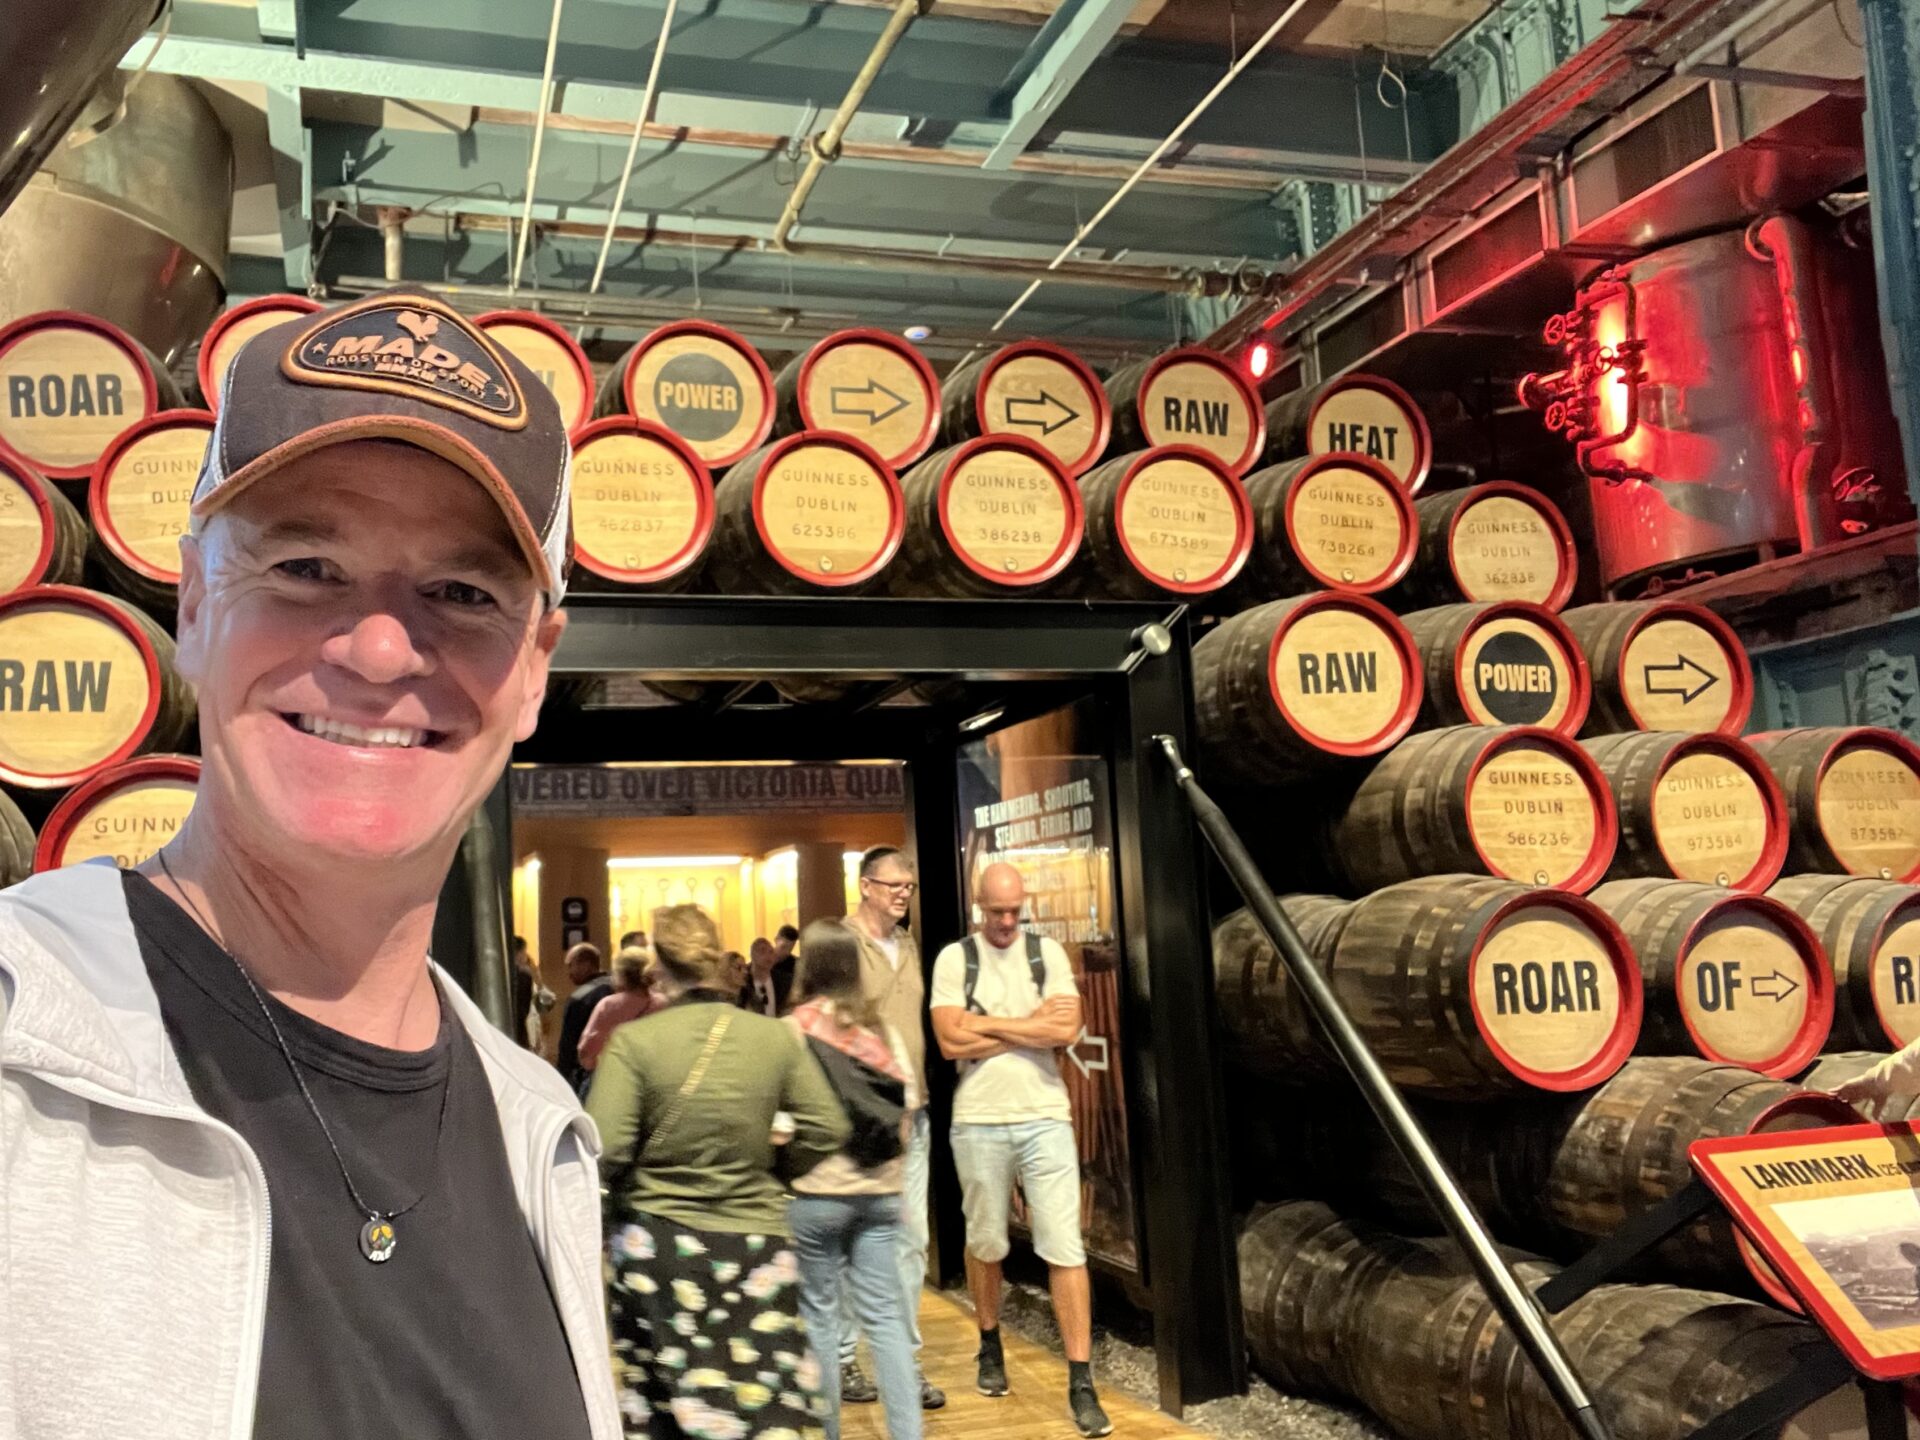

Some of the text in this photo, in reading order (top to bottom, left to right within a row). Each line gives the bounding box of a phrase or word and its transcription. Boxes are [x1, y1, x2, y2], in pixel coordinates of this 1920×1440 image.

[328, 336, 491, 389] MADE
[326, 354, 486, 398] ROOSTER OF SPORT
[8, 374, 123, 418] ROAR
[660, 381, 737, 411] POWER
[1164, 396, 1229, 437] RAW
[1329, 422, 1398, 460] HEAT
[581, 461, 675, 476] GUINNESS
[782, 469, 870, 486] GUINNESS
[966, 475, 1048, 490] GUINNESS
[595, 488, 661, 503] DUBLIN
[1141, 480, 1220, 500] GUINNESS
[1309, 489, 1385, 507] GUINNESS
[796, 496, 857, 512] DUBLIN
[979, 501, 1037, 515] DUBLIN
[1151, 507, 1206, 522] DUBLIN
[1320, 514, 1374, 530] DUBLIN
[1467, 522, 1538, 535] GUINNESS
[1481, 546, 1531, 557] DUBLIN
[1298, 651, 1377, 694] RAW
[1479, 663, 1552, 692] POWER
[0, 659, 112, 713] RAW
[705, 767, 837, 799] VICTORIA
[1488, 772, 1574, 786] GUINNESS
[1667, 775, 1745, 792] GUINNESS
[1504, 801, 1563, 815] DUBLIN
[1682, 803, 1737, 820] DUBLIN
[1846, 799, 1900, 811] DUBLIN
[1493, 960, 1600, 1015] ROAR
[1696, 961, 1742, 1012] OF
[1740, 1154, 1881, 1190] LANDMARK
